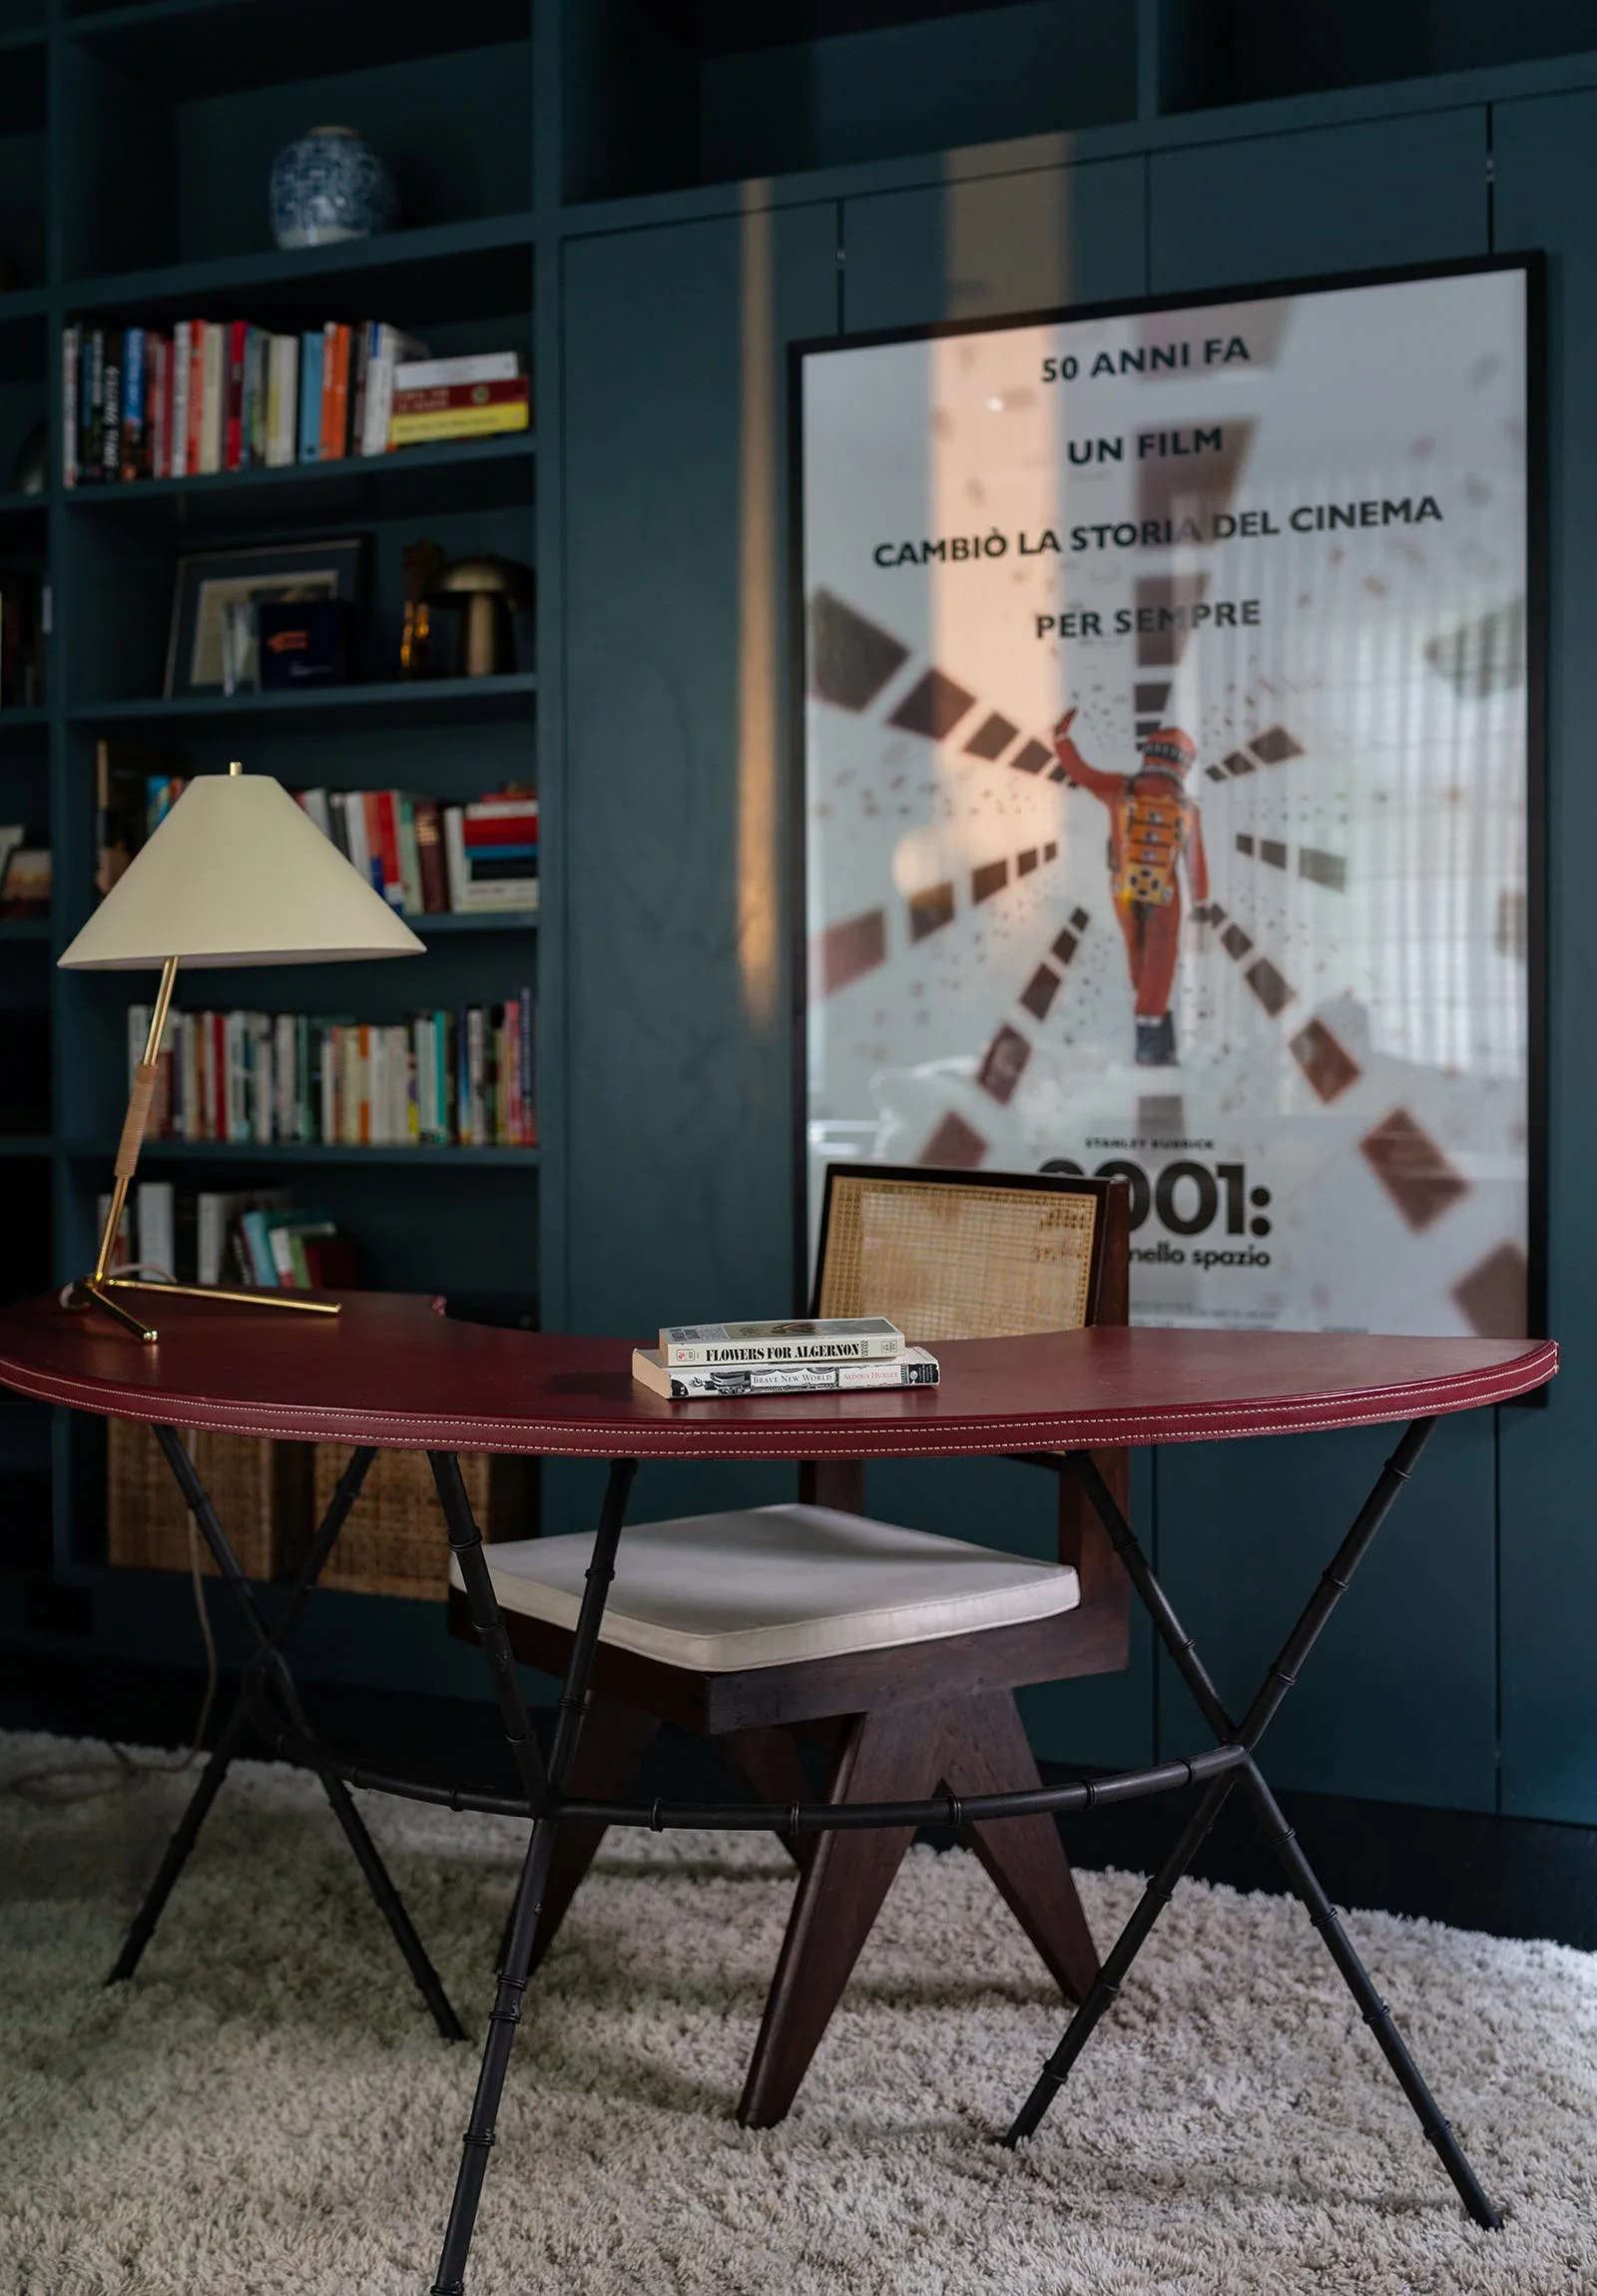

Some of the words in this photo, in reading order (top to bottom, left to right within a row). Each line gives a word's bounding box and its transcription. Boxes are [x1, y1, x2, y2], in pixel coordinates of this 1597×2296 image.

[1041, 354, 1080, 383] 50
[1089, 342, 1191, 377] ANNI
[1204, 336, 1252, 364] FA
[1067, 436, 1123, 465] UN
[1138, 427, 1223, 458] FILM
[872, 527, 1008, 568] CAMBIÒ
[1018, 529, 1061, 555] LA
[1070, 517, 1203, 551] STORIA
[1212, 510, 1281, 539] DEL
[1289, 495, 1443, 534] CINEMA
[1035, 611, 1103, 640] PER
[1113, 599, 1261, 635] SEMPRE
[1129, 1241, 1186, 1265] nello
[1192, 1244, 1272, 1272] spazio
[706, 1348, 765, 1362] FLOWERS
[767, 1347, 792, 1360] FOR
[795, 1343, 859, 1359] ALGERNON
